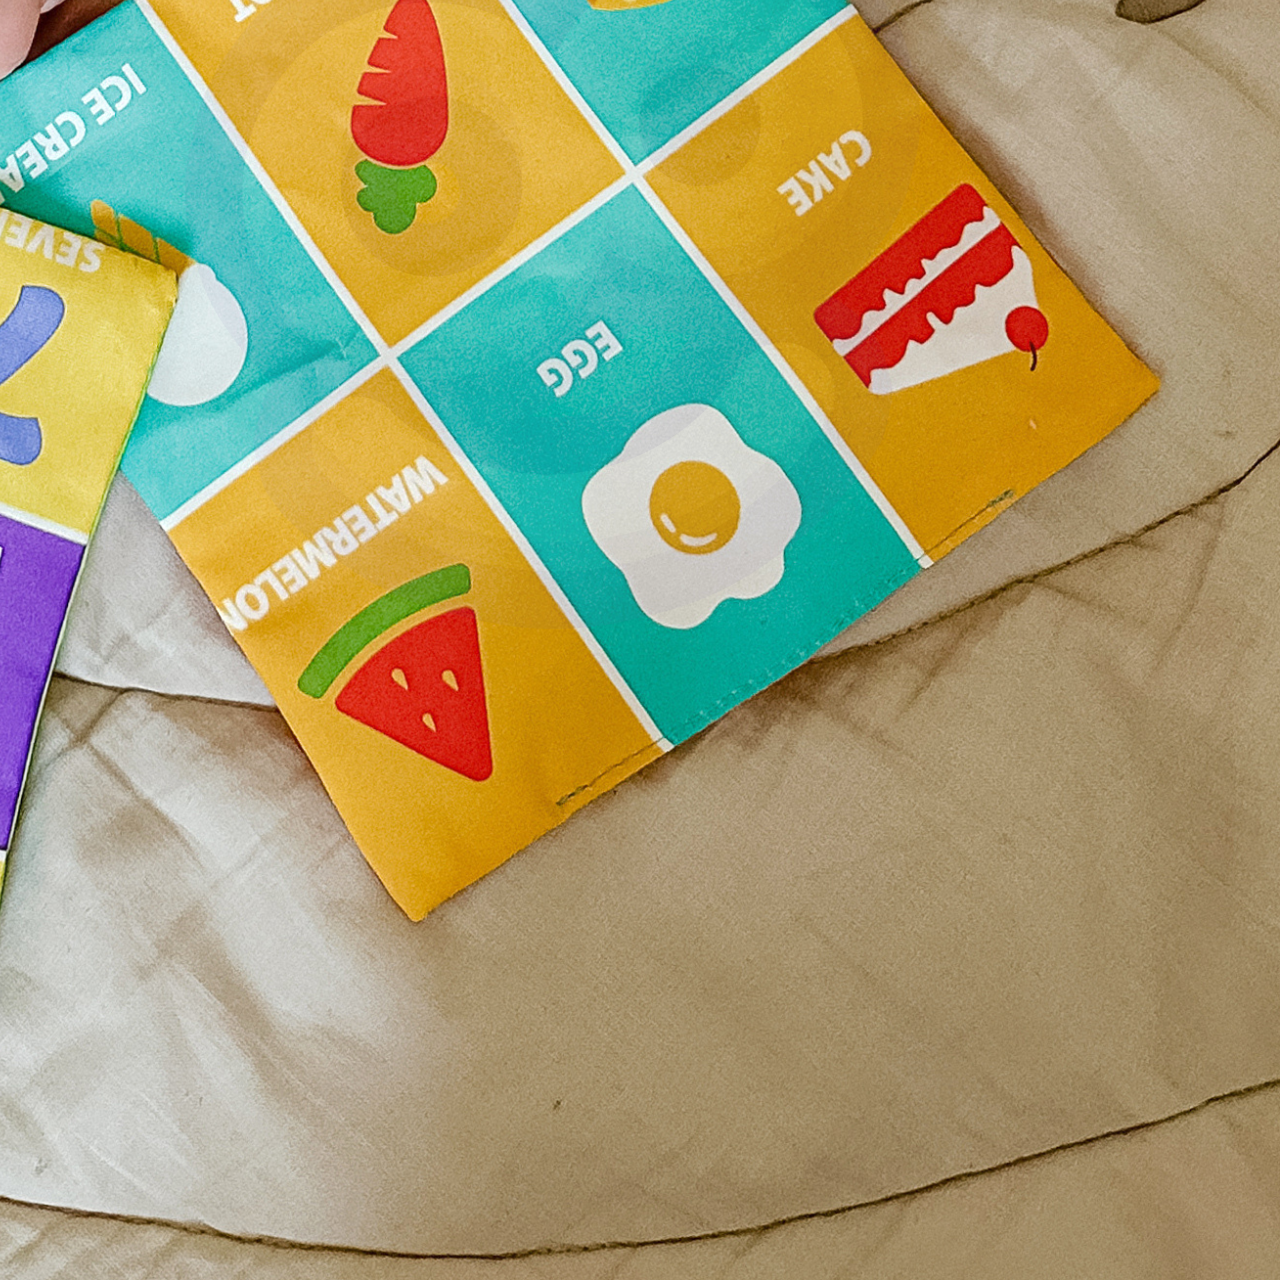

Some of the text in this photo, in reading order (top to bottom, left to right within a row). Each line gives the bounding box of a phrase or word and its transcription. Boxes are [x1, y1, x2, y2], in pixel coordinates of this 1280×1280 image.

[82, 62, 148, 126] ICE
[776, 130, 873, 217] CAKE
[536, 319, 623, 397] EGG
